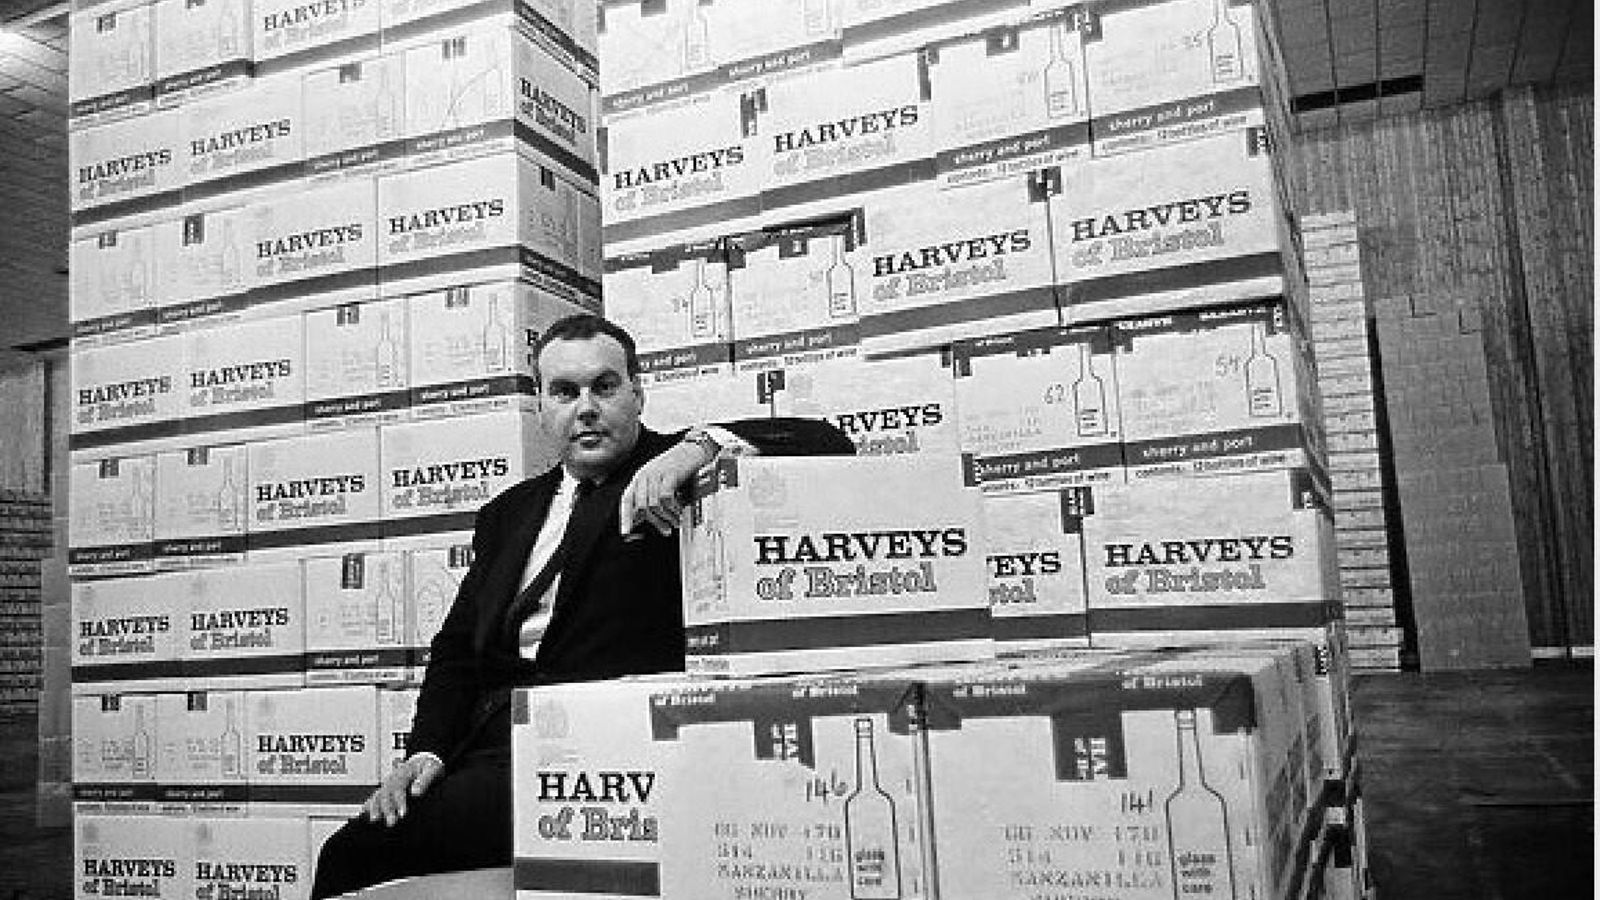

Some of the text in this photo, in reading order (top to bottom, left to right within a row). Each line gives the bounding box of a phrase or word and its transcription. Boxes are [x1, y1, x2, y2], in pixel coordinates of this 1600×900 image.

[518, 77, 587, 133] HARVEYS
[1109, 100, 1214, 132] sherry and port
[191, 119, 291, 155] HARVEYS
[774, 104, 918, 152] HARVEYS
[954, 150, 993, 165] sherry
[1024, 134, 1049, 151] port
[79, 149, 172, 183] HARVEYS
[613, 146, 744, 189] HARVEYS
[388, 198, 504, 235] HARVEYS
[1070, 190, 1252, 243] HARVEYS
[257, 223, 363, 258] HARVEYS
[872, 229, 1032, 277] HARVEYS
[1071, 220, 1225, 268] of Bristol
[873, 276, 901, 301] of
[905, 257, 1007, 297] Bristol
[190, 359, 291, 389] HARVEYS
[79, 375, 172, 405] HARVEYS
[1143, 436, 1252, 459] sherry and port
[392, 458, 509, 487] HARVEYS
[257, 475, 365, 502] HARVEYS
[754, 527, 968, 565] HARVEYS
[1105, 536, 1294, 568] HARVEYS
[985, 551, 1062, 578] EYS
[1105, 563, 1266, 595] of Bristol
[756, 560, 937, 601] of Bristol
[79, 615, 170, 637] HARVEYS
[190, 607, 289, 631] HARVEYS
[190, 627, 273, 651] of Bristol
[793, 683, 859, 699] of Bristol
[953, 681, 1028, 698] of Bristol
[1122, 673, 1203, 691] of Bristol
[654, 691, 716, 706] of Bristol
[257, 734, 366, 753] HARVEYS
[257, 754, 348, 775] of Bristol
[537, 771, 656, 802] HARV
[806, 769, 849, 805] 146
[1121, 788, 1153, 814] 141
[537, 806, 659, 843] of Bris
[82, 858, 175, 878] HARVEYS
[854, 848, 885, 863] glass
[1177, 851, 1218, 866] glass
[195, 861, 297, 883] HARVEYS
[855, 876, 882, 887] care
[1180, 866, 1212, 879] with
[82, 877, 161, 898] of Bristol
[195, 881, 280, 900] of Bristol
[1181, 883, 1214, 895] care
